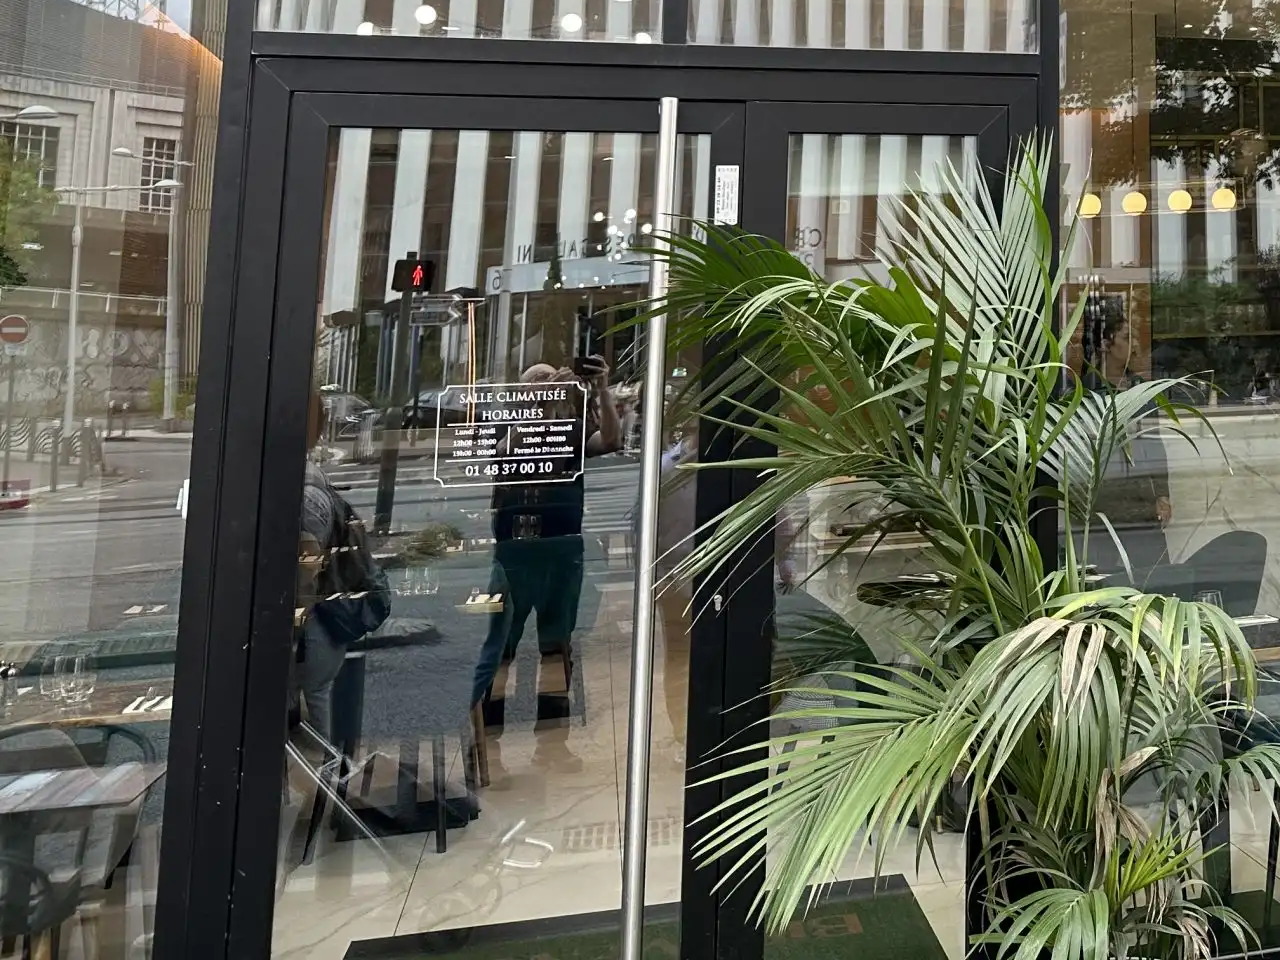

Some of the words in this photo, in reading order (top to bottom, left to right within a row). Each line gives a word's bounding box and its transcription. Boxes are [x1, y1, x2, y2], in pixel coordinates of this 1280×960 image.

[459, 392, 493, 404] SALLE
[496, 388, 567, 403] CLIMATISÉE
[482, 408, 544, 421] HORAIRES
[465, 465, 480, 477] 01
[483, 464, 499, 476] 48
[501, 462, 516, 475] 37
[519, 462, 535, 474] 00
[538, 461, 553, 473] 10
